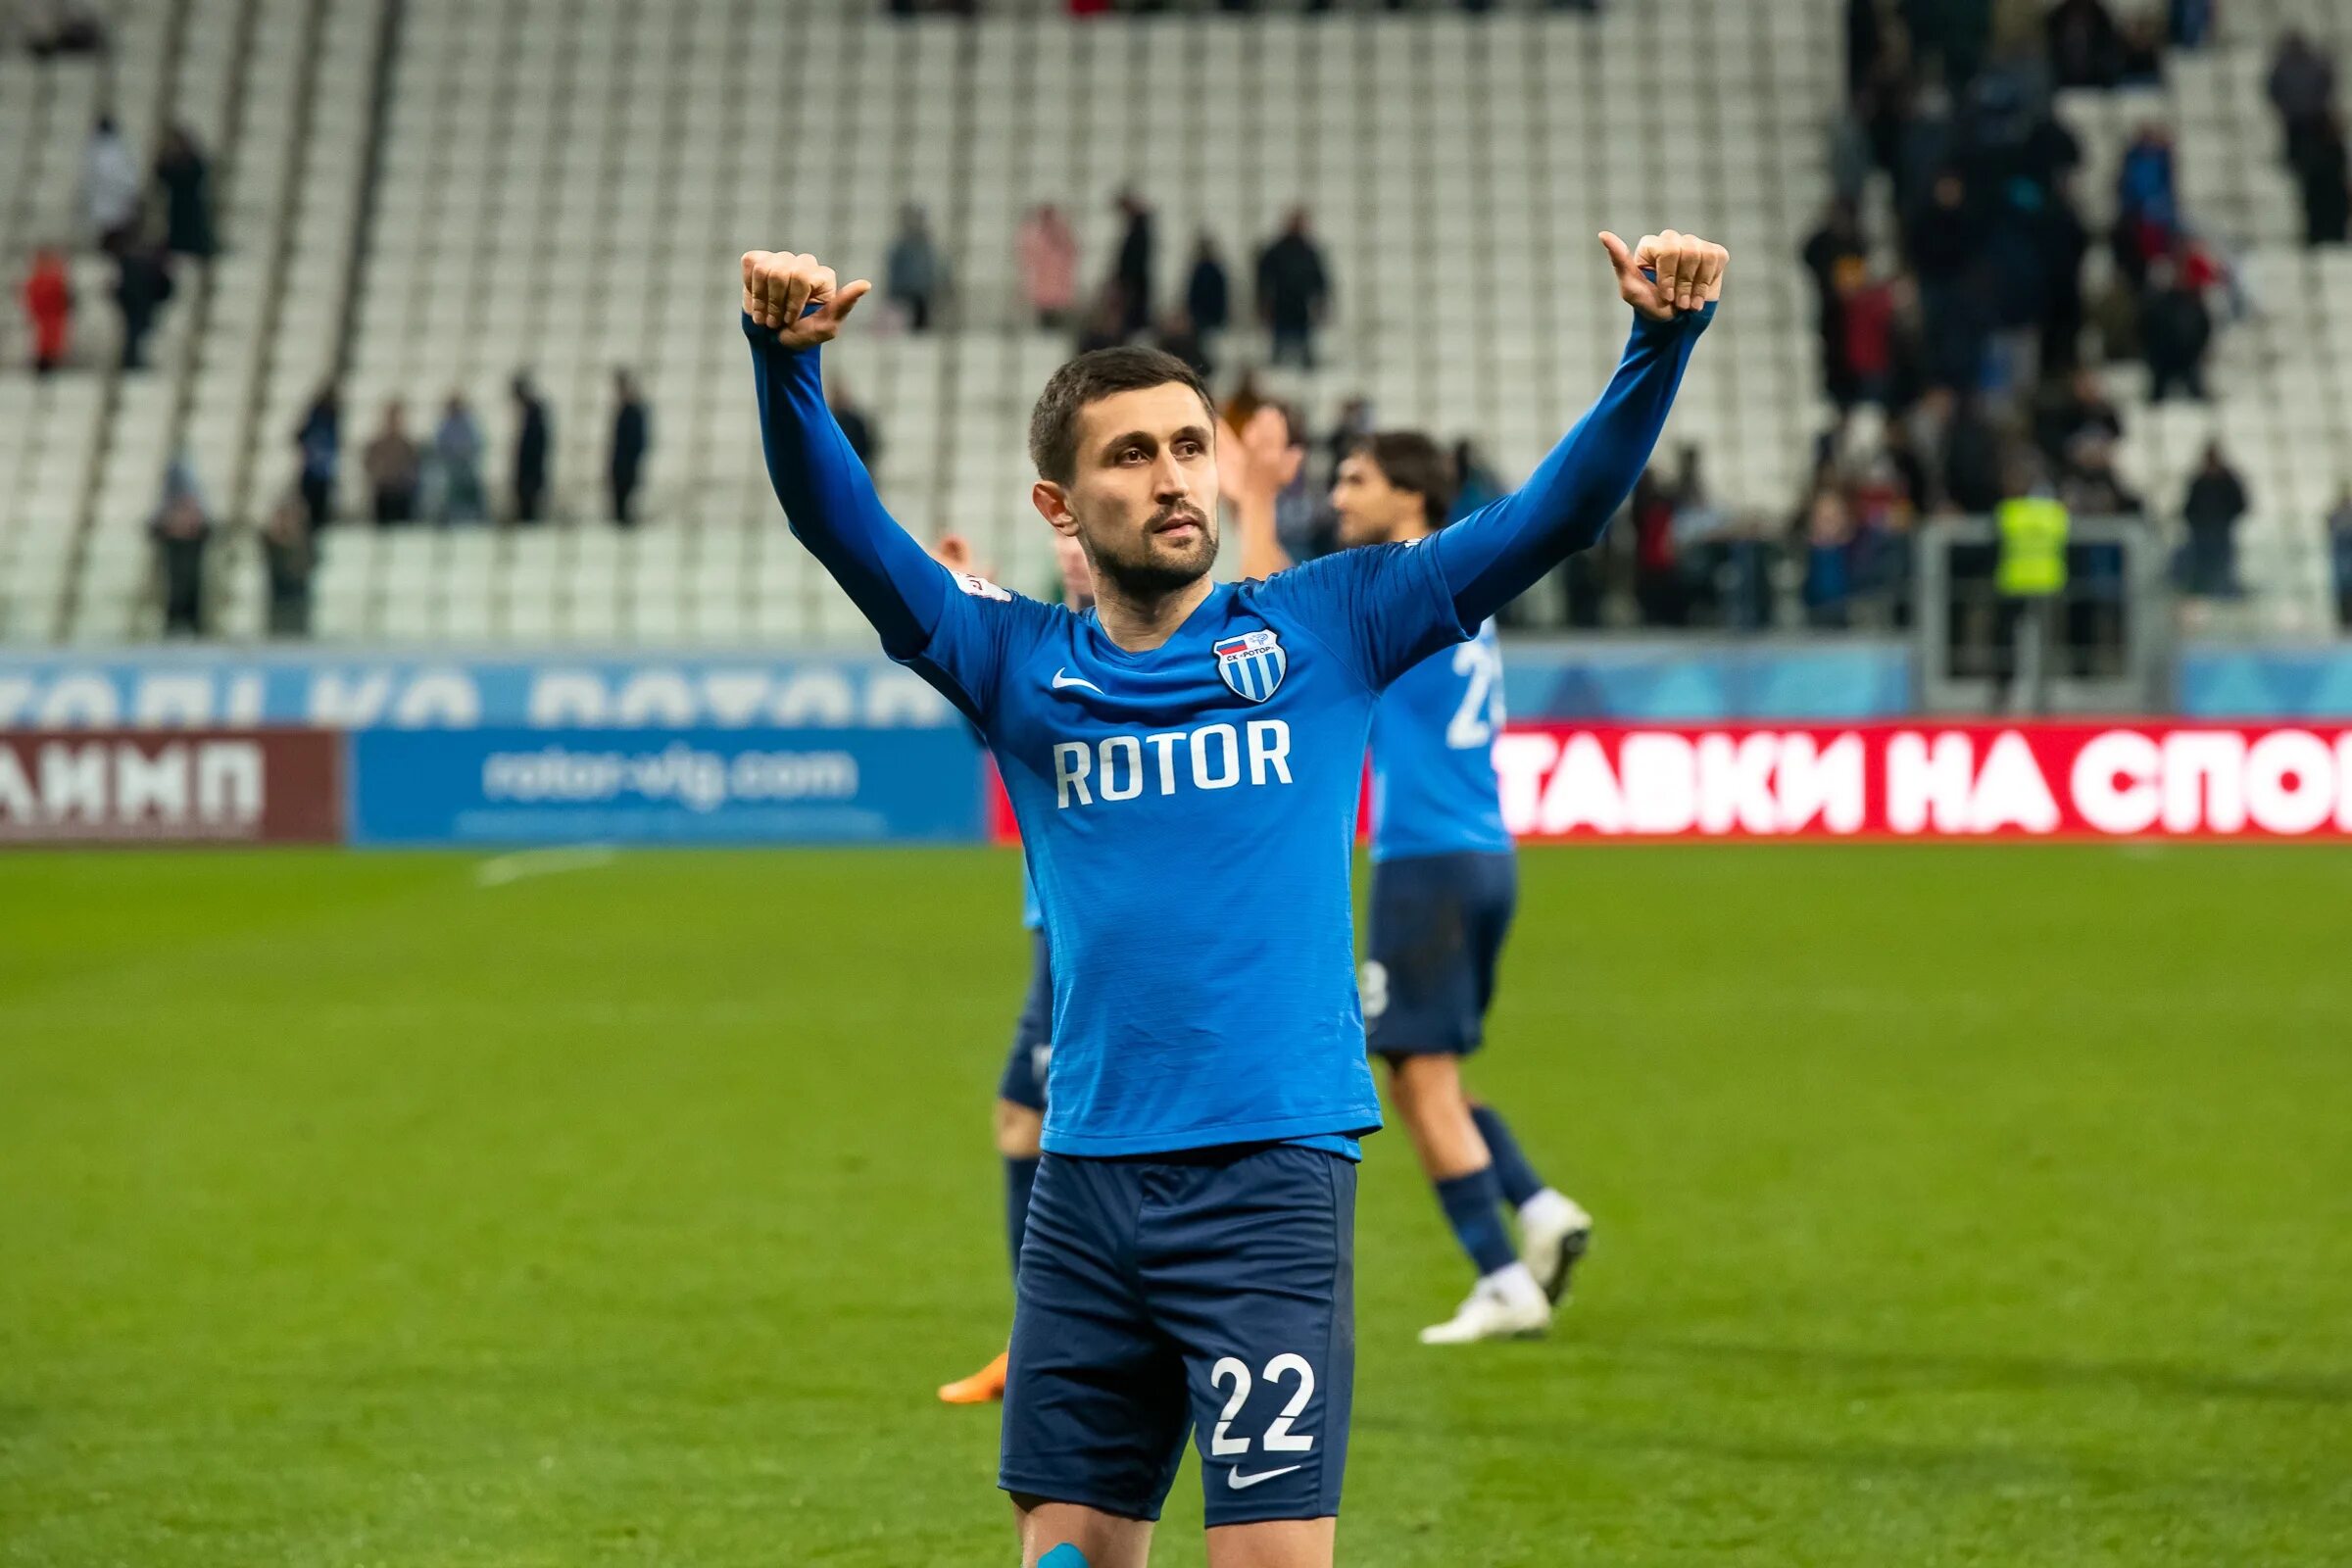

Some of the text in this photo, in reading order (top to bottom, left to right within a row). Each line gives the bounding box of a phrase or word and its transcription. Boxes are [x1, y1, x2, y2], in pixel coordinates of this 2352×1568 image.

[1054, 719, 1293, 809] ROTOR
[1886, 730, 2061, 834] НА
[2071, 729, 2352, 834] СПО
[1211, 1353, 1314, 1455] 22
